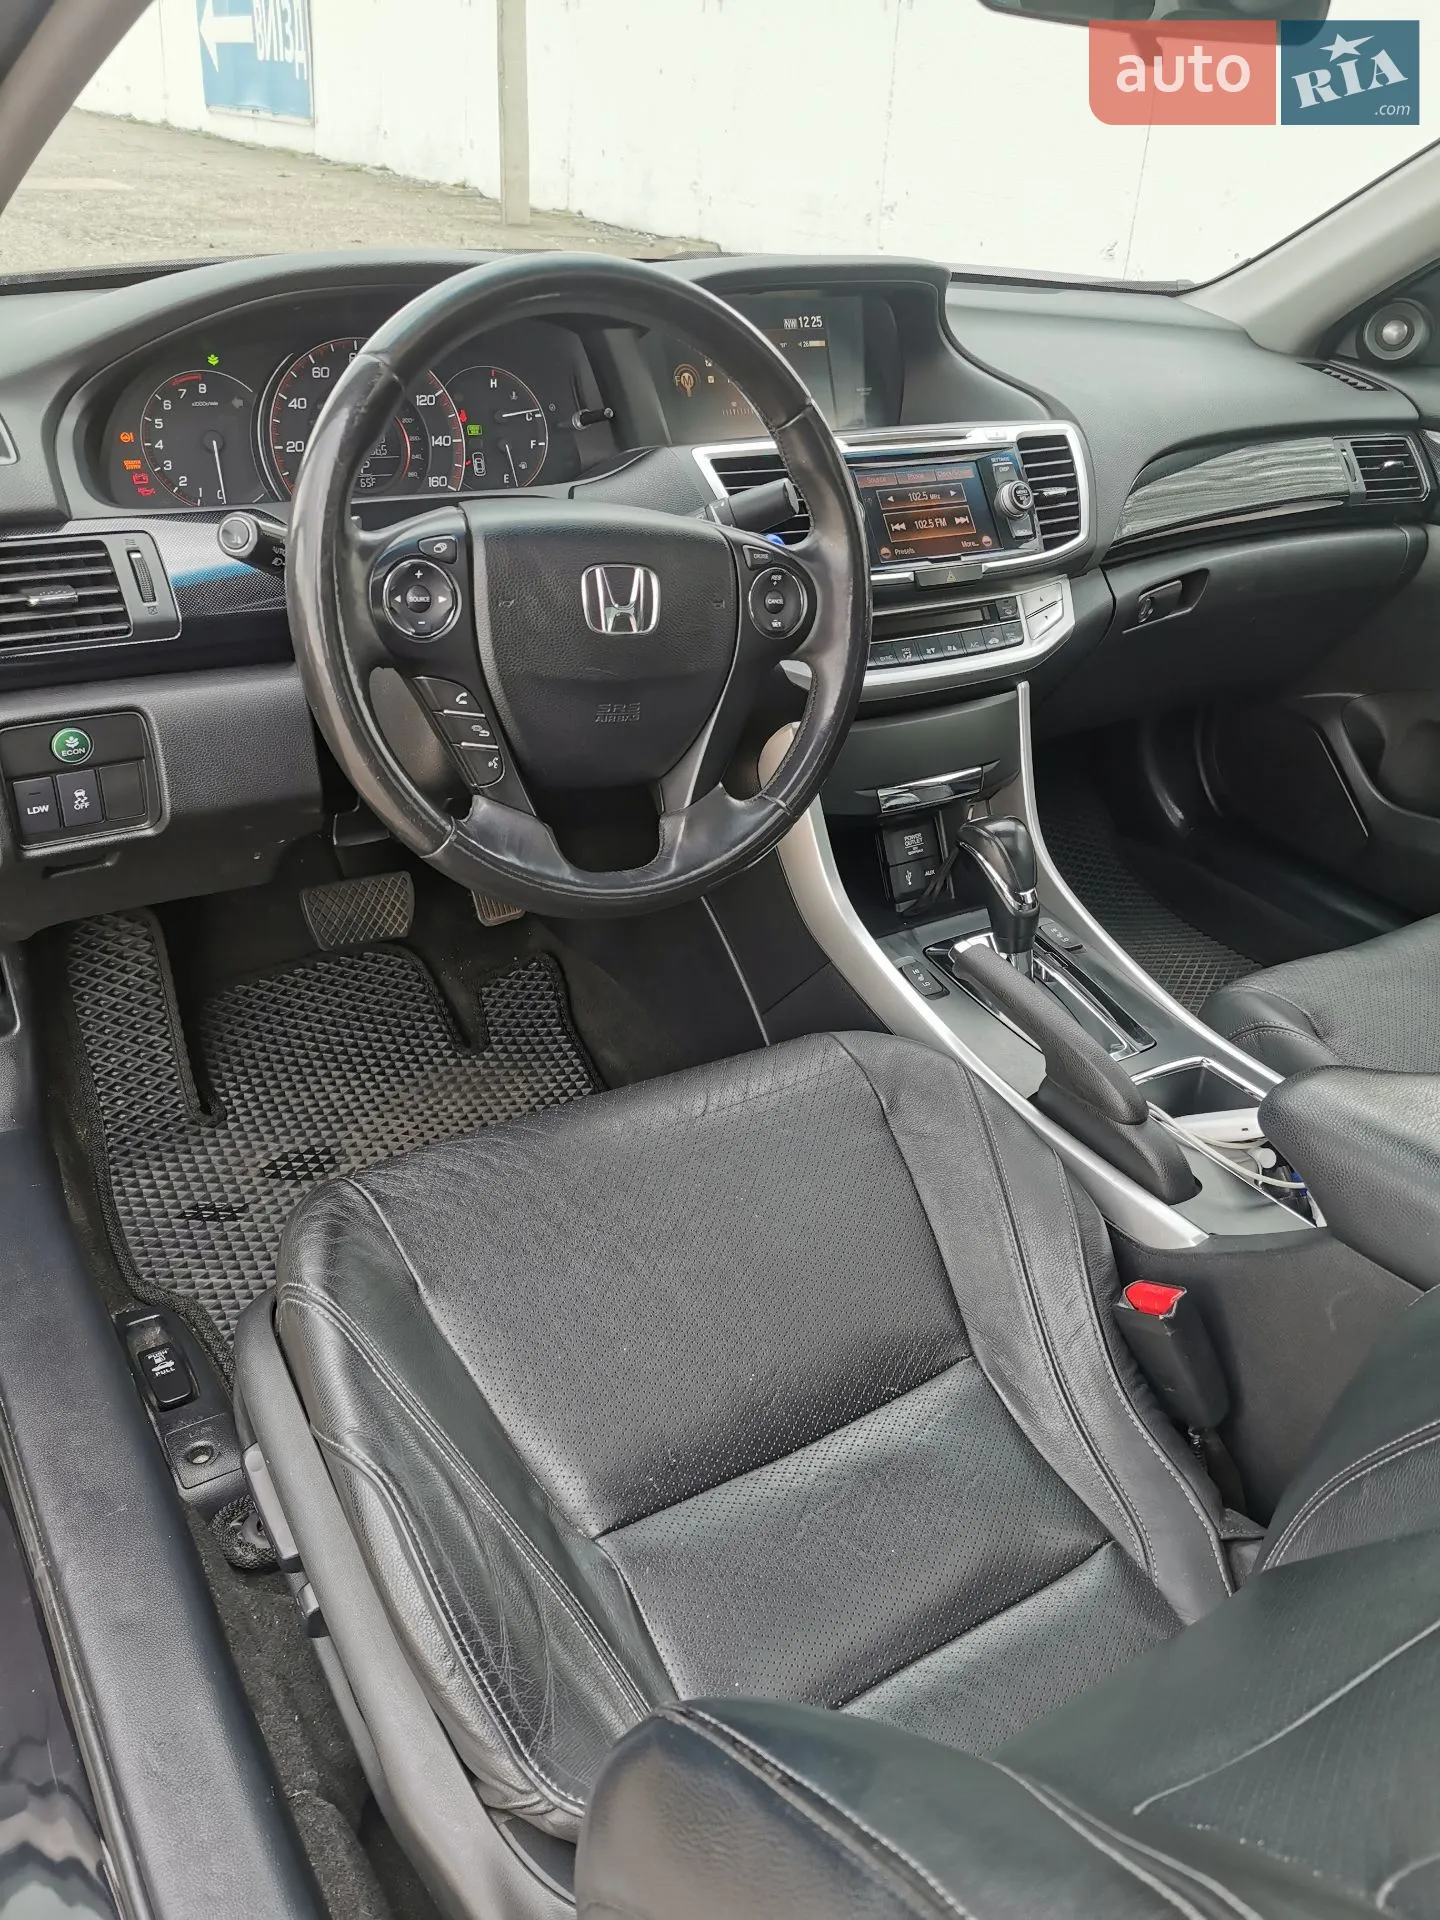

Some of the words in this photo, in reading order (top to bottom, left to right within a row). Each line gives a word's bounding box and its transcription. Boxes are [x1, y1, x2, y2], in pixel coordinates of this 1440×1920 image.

[312, 367, 329, 378] 60
[198, 383, 207, 394] 8
[490, 379, 497, 388] H
[178, 389, 186, 398] 7
[163, 400, 172, 411] 6
[287, 398, 307, 409] 40
[415, 394, 436, 406] 120
[154, 419, 163, 429] 5
[154, 440, 163, 450] 4
[431, 435, 451, 447] 140
[530, 439, 536, 448] F
[286, 441, 305, 453] 20
[163, 460, 172, 470] 3
[178, 476, 188, 487] 2
[428, 476, 448, 488] 160
[503, 474, 510, 483] E
[908, 491, 928, 502] 102.5
[914, 519, 934, 530] 102.5
[934, 517, 948, 528] FM
[597, 702, 641, 713] SRS
[61, 747, 86, 757] ECON
[27, 804, 49, 815] LDW
[903, 832, 922, 841] POWER
[155, 1368, 175, 1377] PULL
